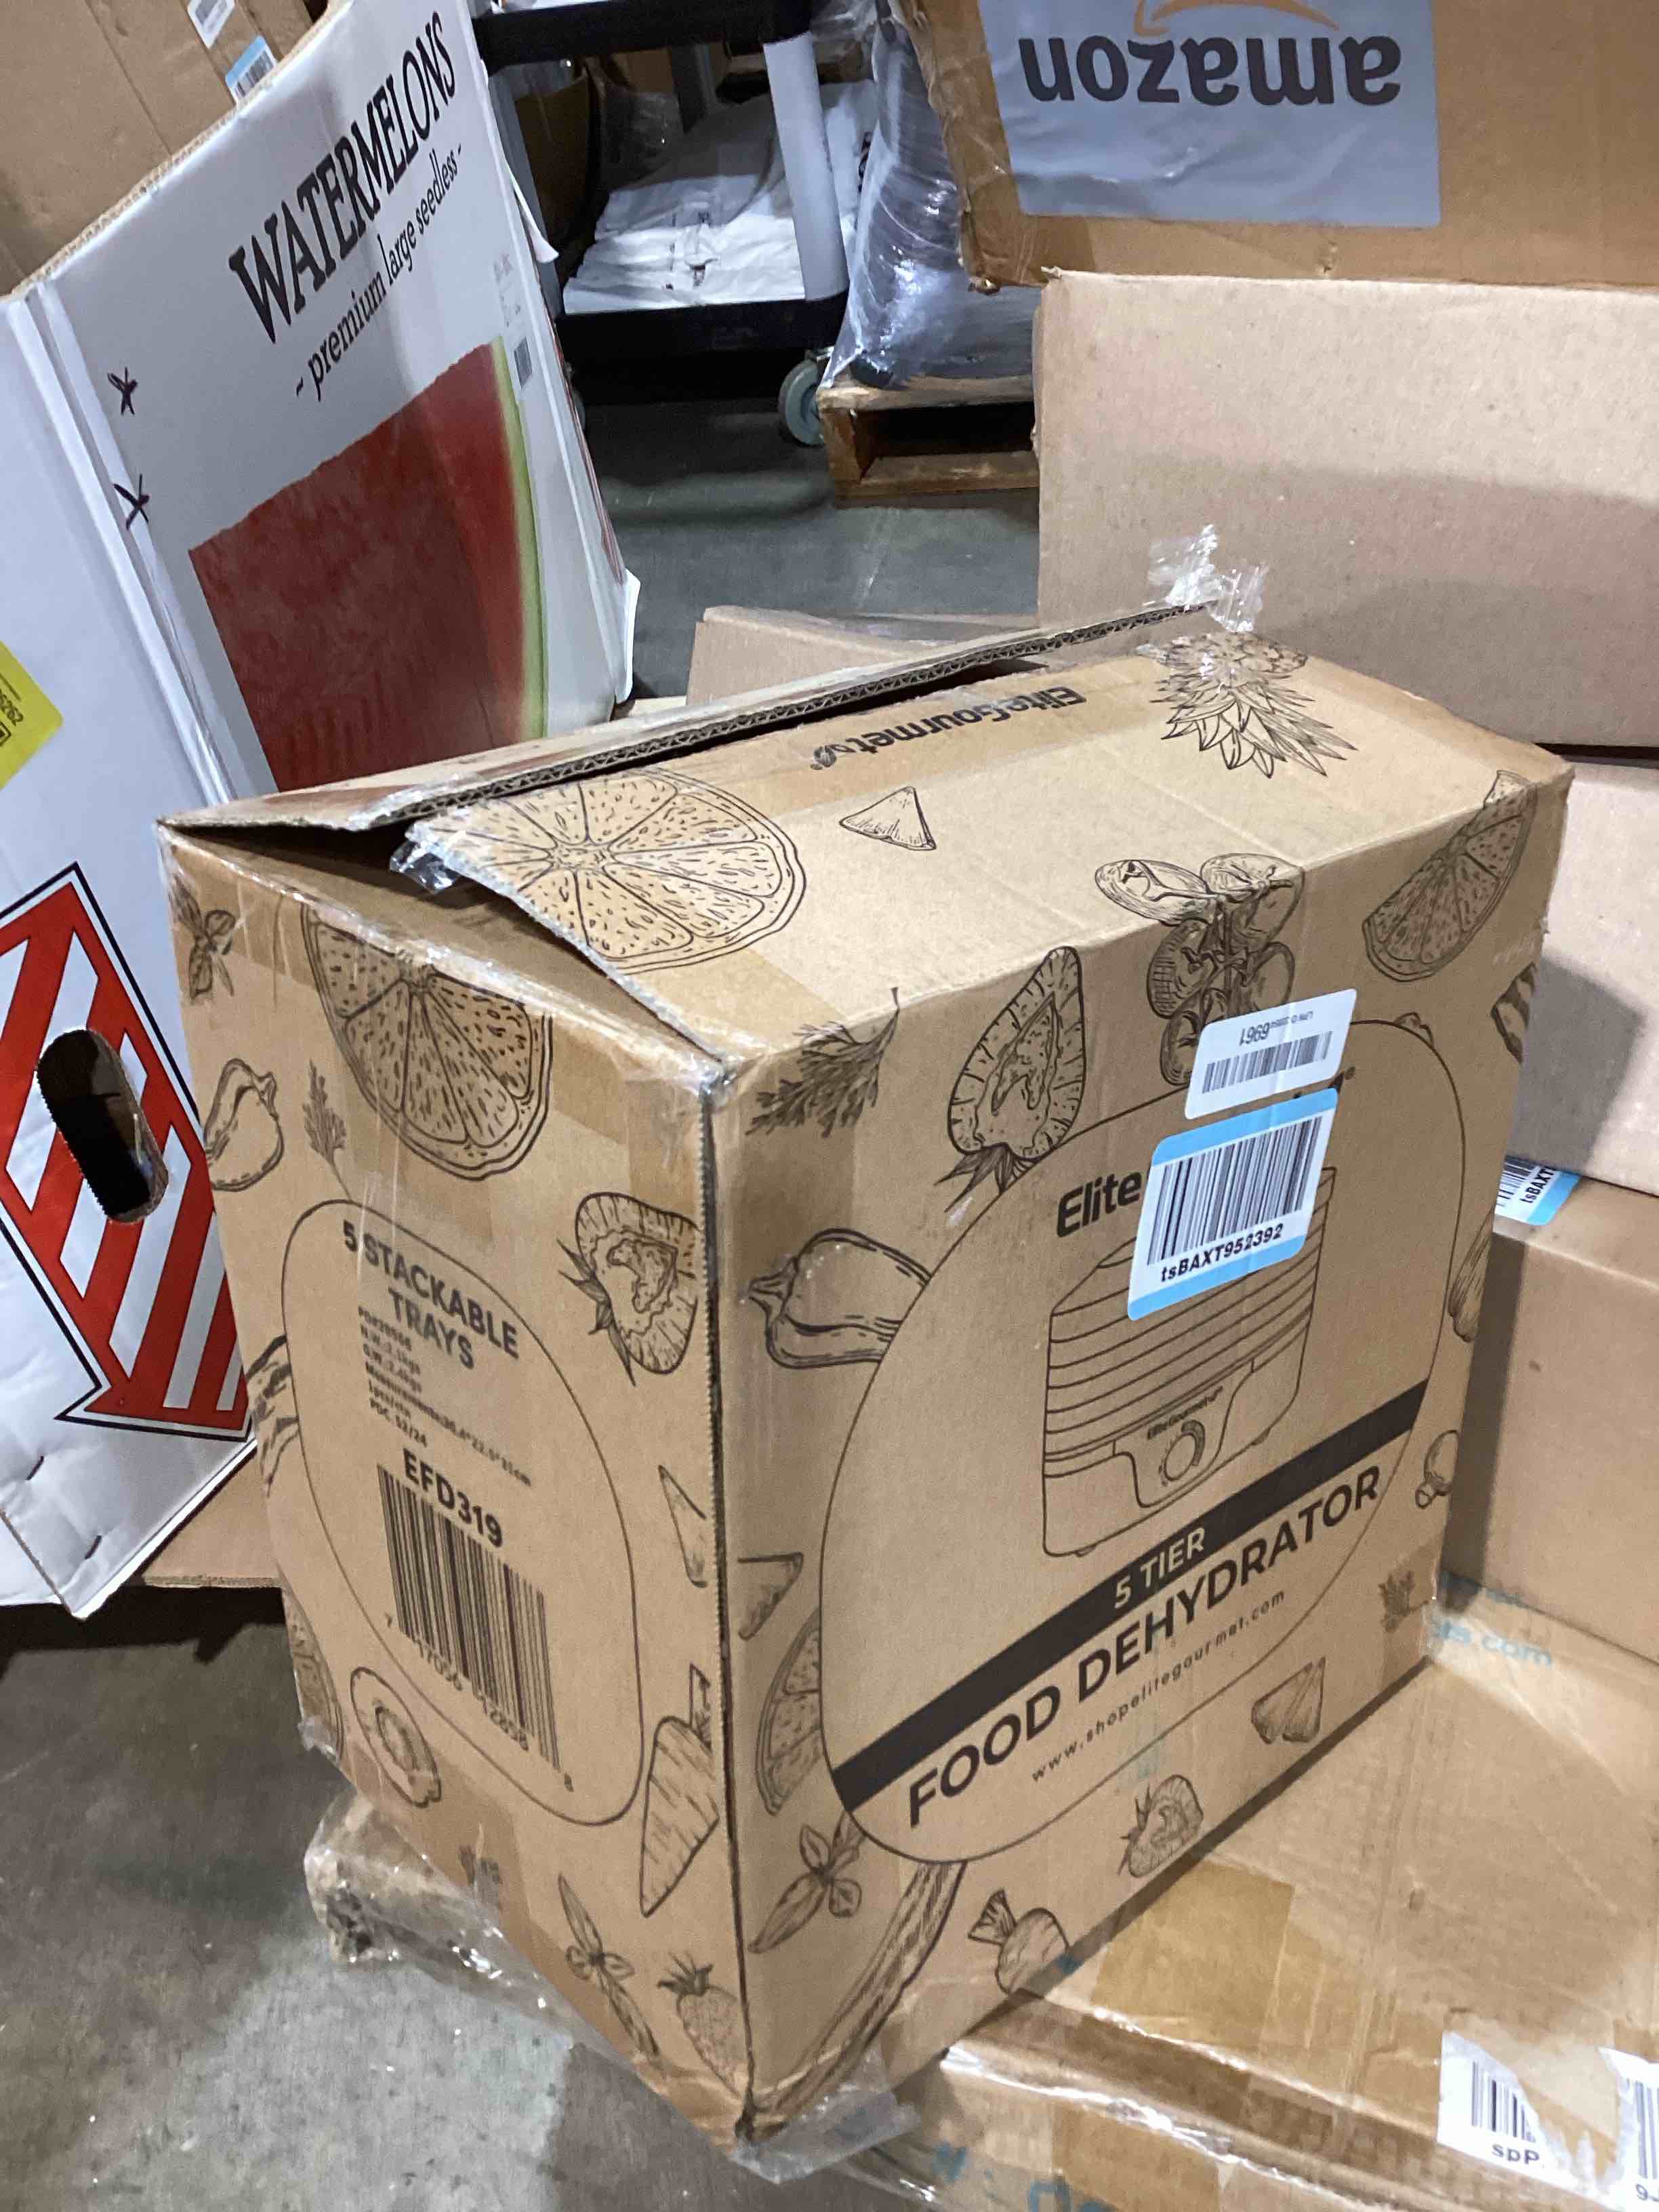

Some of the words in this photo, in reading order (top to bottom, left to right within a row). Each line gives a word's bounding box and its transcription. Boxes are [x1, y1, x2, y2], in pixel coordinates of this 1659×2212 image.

[1018, 34, 1401, 106] amazon
[229, 11, 456, 344] WATERMELONS
[377, 217, 415, 285] large
[1056, 1170, 1143, 1237] Elite
[343, 1220, 358, 1252] 5
[363, 1231, 519, 1361] STACKABLE
[1161, 1223, 1284, 1283] tsBAXT952392
[388, 1286, 474, 1370] TRAYS
[403, 1448, 504, 1549] EFD319
[1113, 1574, 1133, 1610] 5
[1139, 1526, 1206, 1587] TIER
[908, 1683, 1061, 1830] FOOD
[1078, 1465, 1382, 1705] DEHYDRATOR
[1031, 1590, 1285, 1784] www.shopelitegourmet.com
